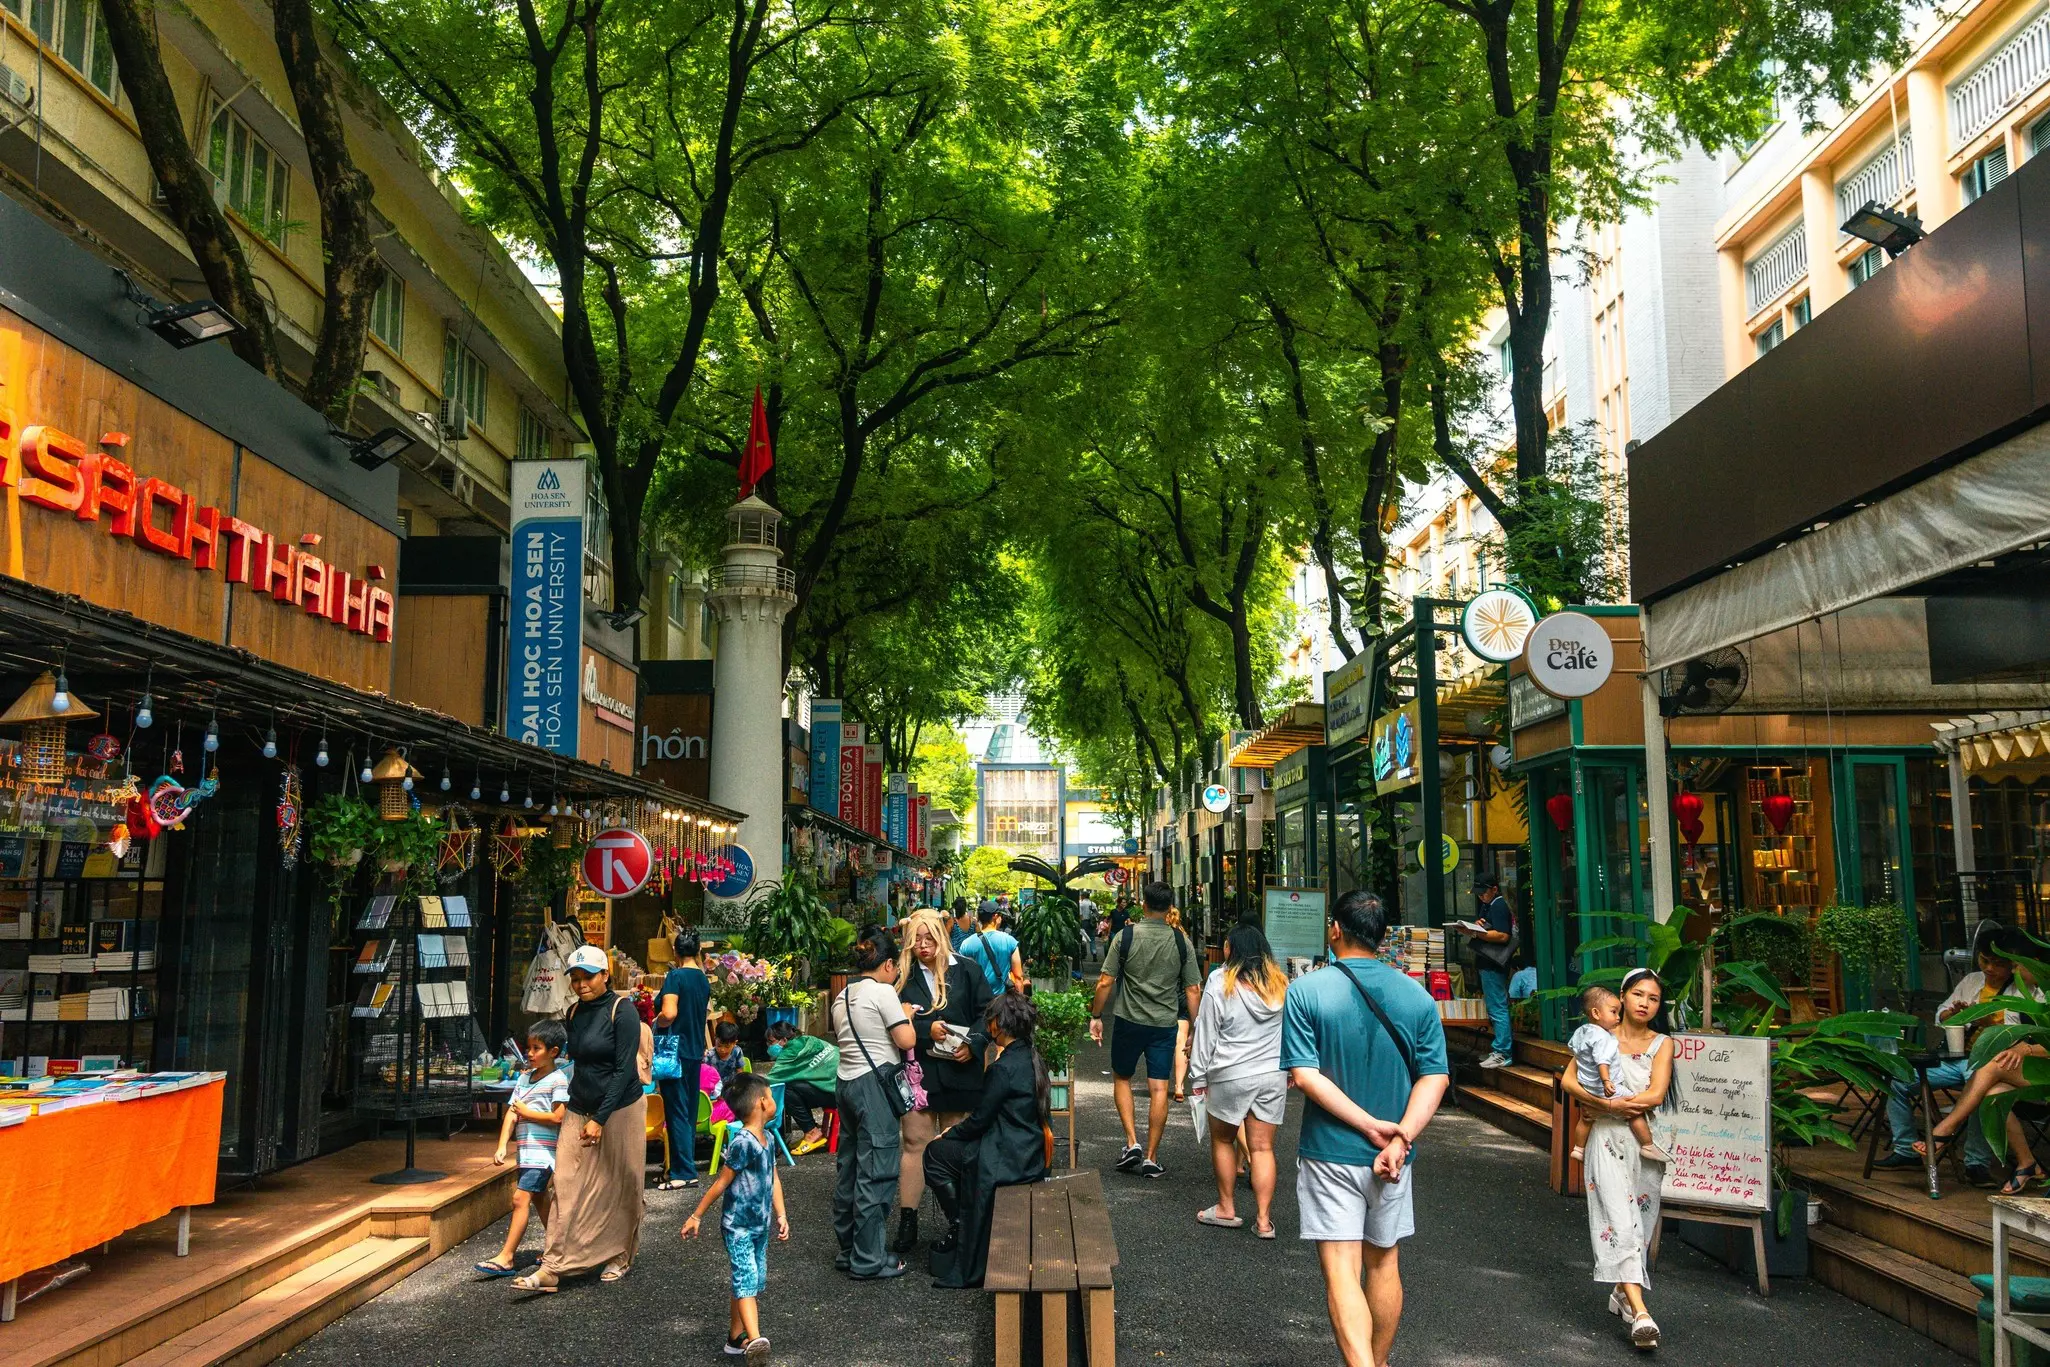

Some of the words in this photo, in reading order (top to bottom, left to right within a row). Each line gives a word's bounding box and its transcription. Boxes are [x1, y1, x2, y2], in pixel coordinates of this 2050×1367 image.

[526, 532, 544, 578] SEN
[548, 532, 566, 650] UNIVERSITY
[525, 584, 543, 638] HOA
[1546, 646, 1598, 670] Café
[1548, 638, 1580, 655] Đẹp
[523, 645, 545, 698] HỌC
[547, 656, 563, 696] SEN
[545, 701, 562, 748] HOA
[843, 748, 853, 759] A
[1691, 1071, 1729, 1084] Vietnamese
[1692, 1082, 1717, 1094] Coconut
[1679, 1100, 1700, 1114] Peach
[1719, 1104, 1740, 1121] Lychee
